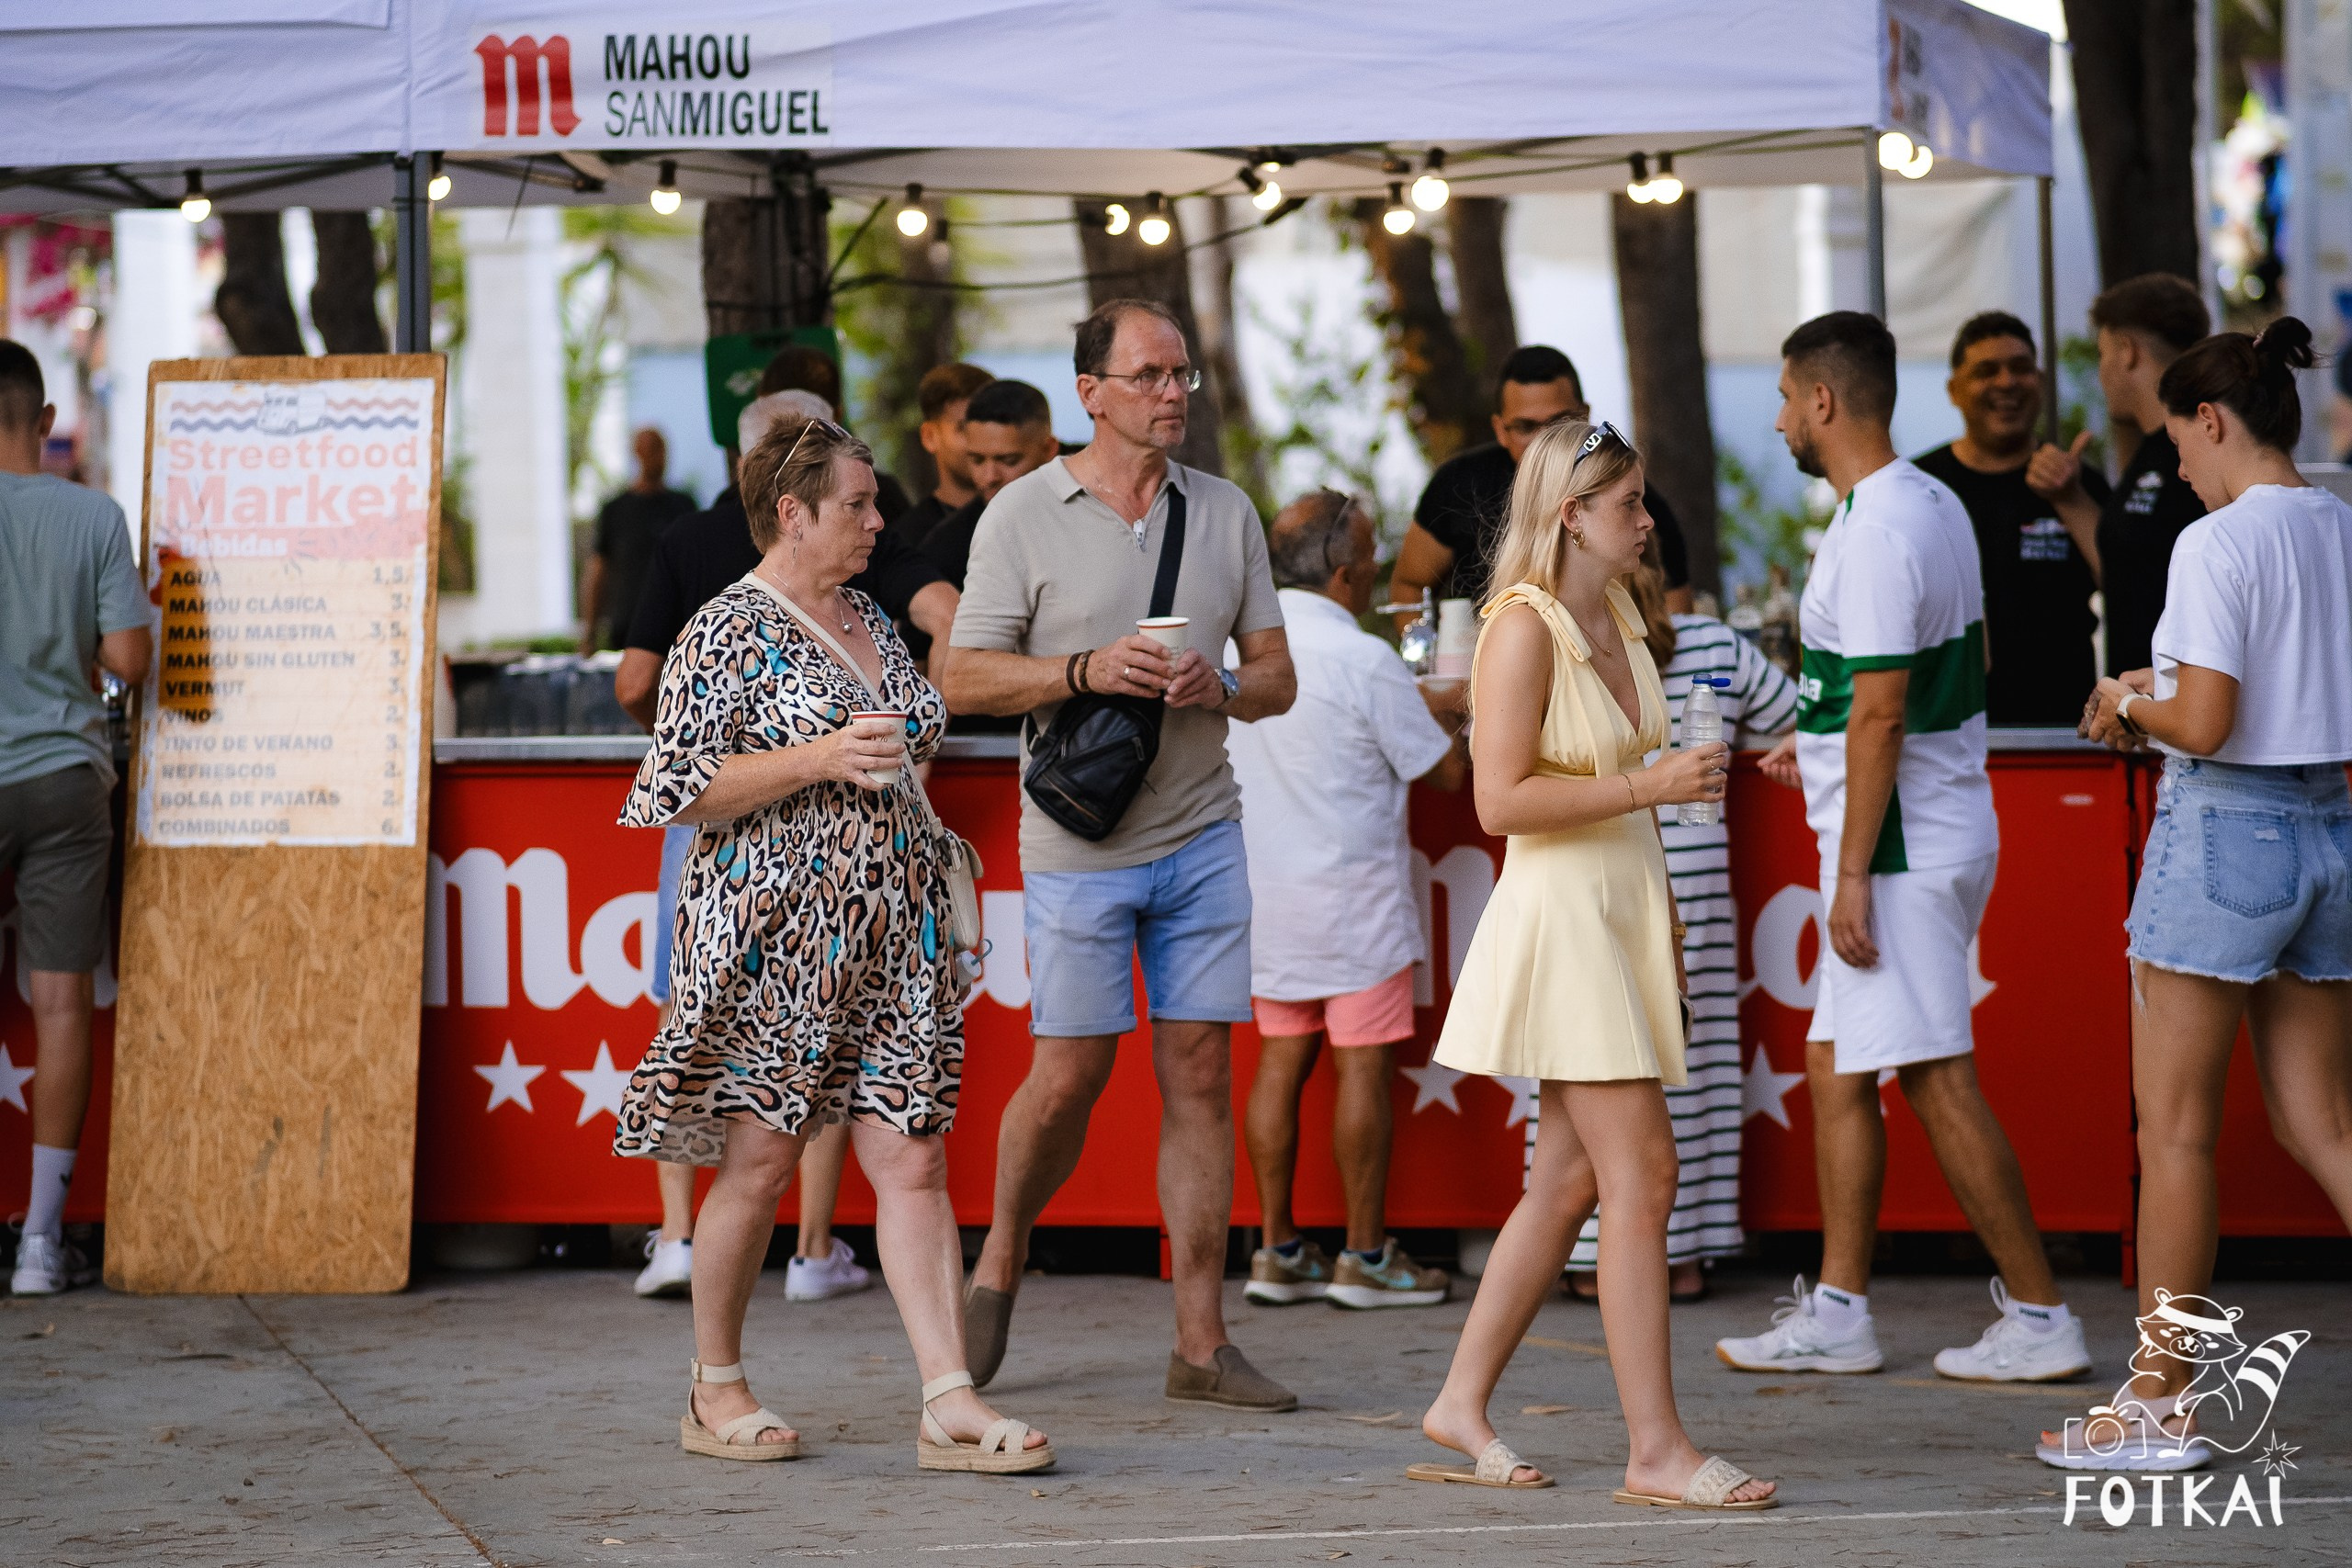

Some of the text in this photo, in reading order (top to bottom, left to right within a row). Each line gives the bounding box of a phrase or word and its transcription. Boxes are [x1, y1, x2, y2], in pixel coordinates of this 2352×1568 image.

[604, 33, 751, 81] MAHOU
[604, 90, 831, 138] SANMIGUEL
[168, 435, 418, 472] Streetfood
[165, 473, 418, 530] Market
[170, 570, 222, 587] AGUA
[168, 597, 241, 615] MAHOU
[167, 625, 240, 641] MAHOU
[244, 624, 336, 641] MAESTRA
[166, 652, 239, 670] MAHOU
[243, 652, 277, 670] SIN
[281, 650, 356, 670] GLUTEN
[165, 680, 245, 698] VERMUT
[164, 707, 224, 724] VINOS
[164, 736, 217, 752] TINTO
[222, 736, 248, 751] DE
[254, 734, 334, 752] VERANO
[160, 790, 224, 807] BOLSA
[230, 791, 254, 807] DE
[260, 789, 341, 807] PATATAS
[158, 818, 291, 836] COMBINADOS
